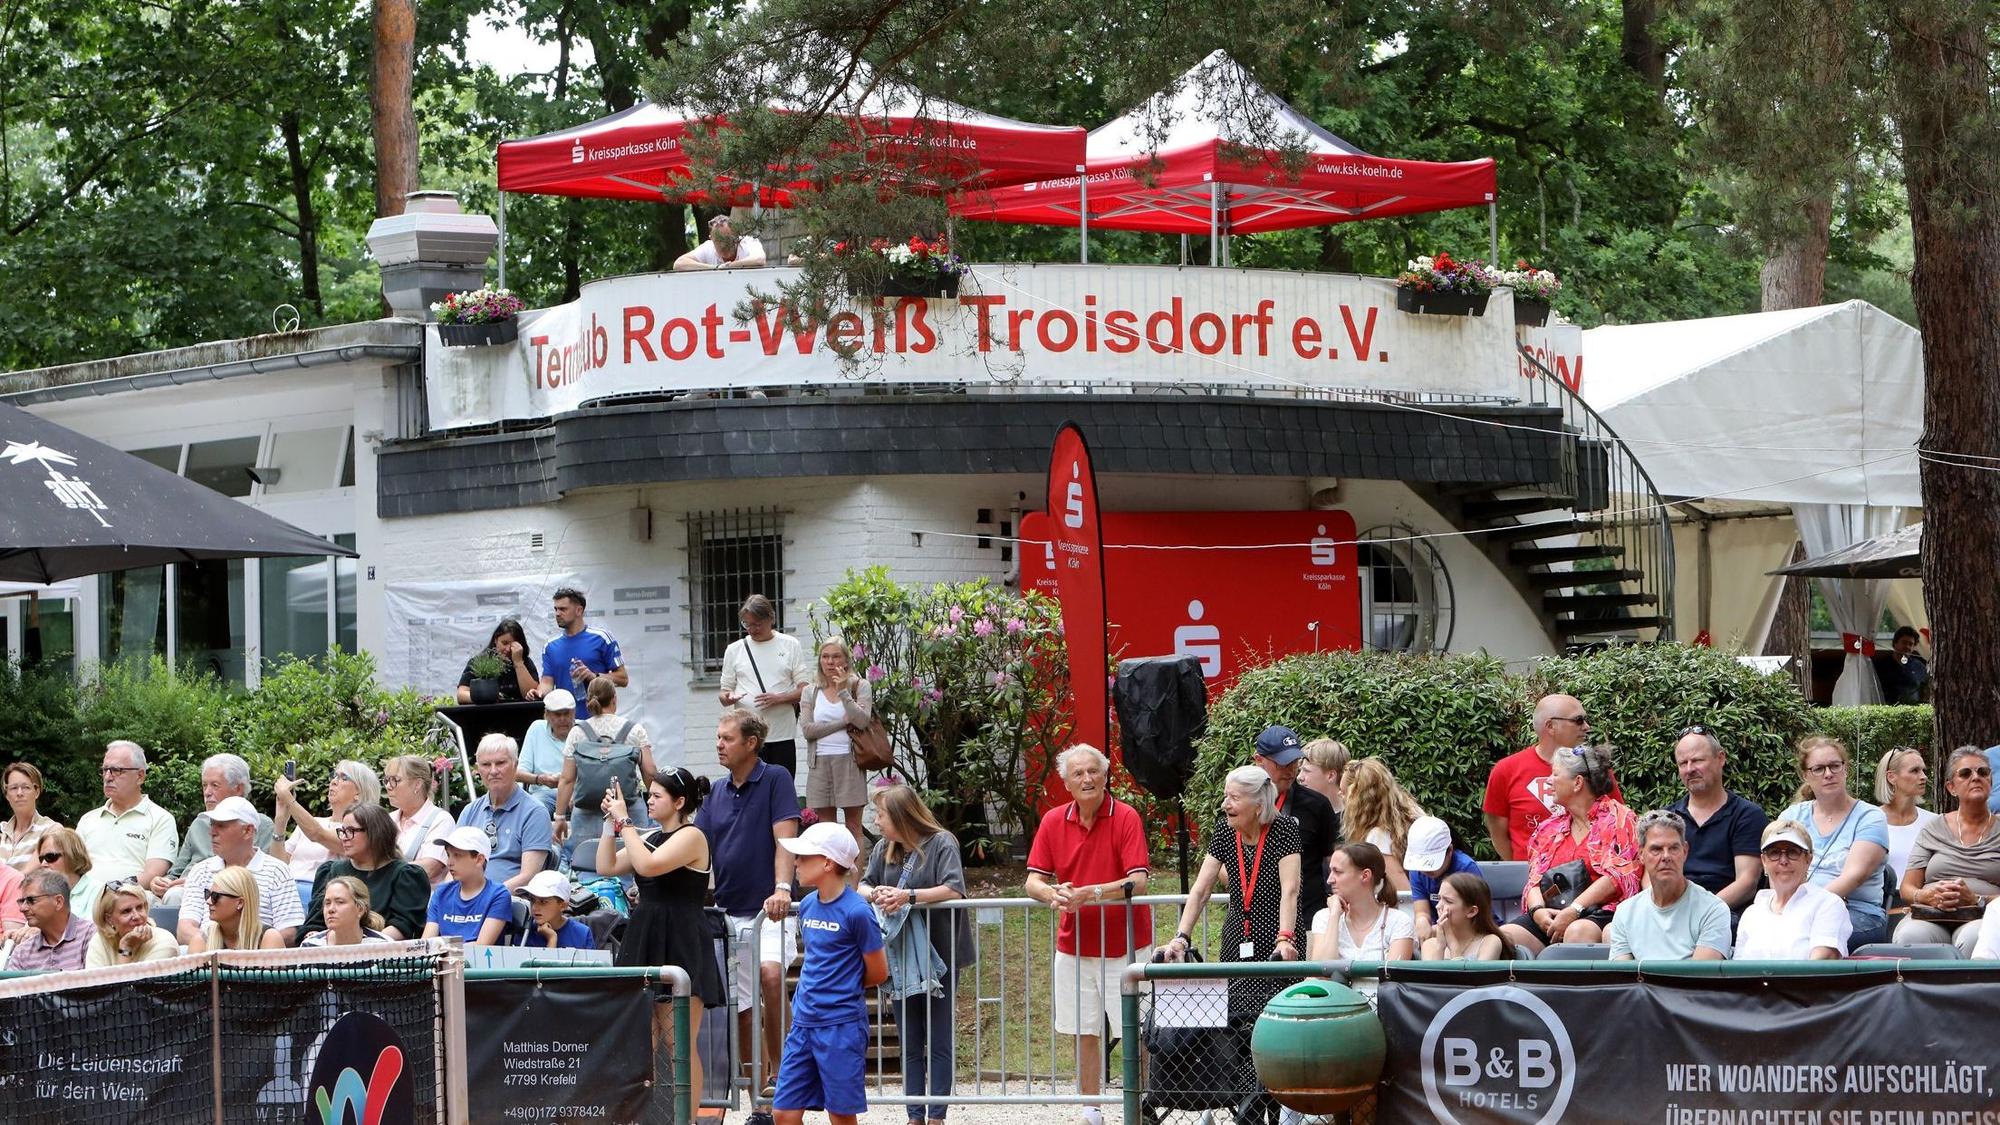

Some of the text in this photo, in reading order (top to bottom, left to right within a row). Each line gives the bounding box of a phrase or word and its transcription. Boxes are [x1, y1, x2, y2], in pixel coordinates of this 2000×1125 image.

[589, 142, 654, 161] Kreissparkasse
[656, 137, 676, 151] Köln
[1317, 163, 1403, 178] www.ksk-koeln.de
[623, 296, 936, 364] Rot-Weiß
[960, 295, 1275, 356] Troisdorf
[1291, 304, 1389, 362] e.V.
[1303, 573, 1346, 582] Kreissparkasse
[803, 919, 840, 932] HEAD
[503, 1041, 589, 1053] Matthias Dorner
[70, 1053, 184, 1073] Leidenschaft
[503, 1057, 581, 1069] Wiedstraße 21
[1443, 1037, 1556, 1088] B&B
[503, 1073, 577, 1086] 47799 Krefeld
[1665, 1060, 1994, 1097] WER WOANDERS AUFSCHLÄGT,
[35, 1080, 149, 1101] für den Wein.
[1459, 1091, 1538, 1110] HOTELS
[503, 1106, 606, 1121] +49(0)172 9378424
